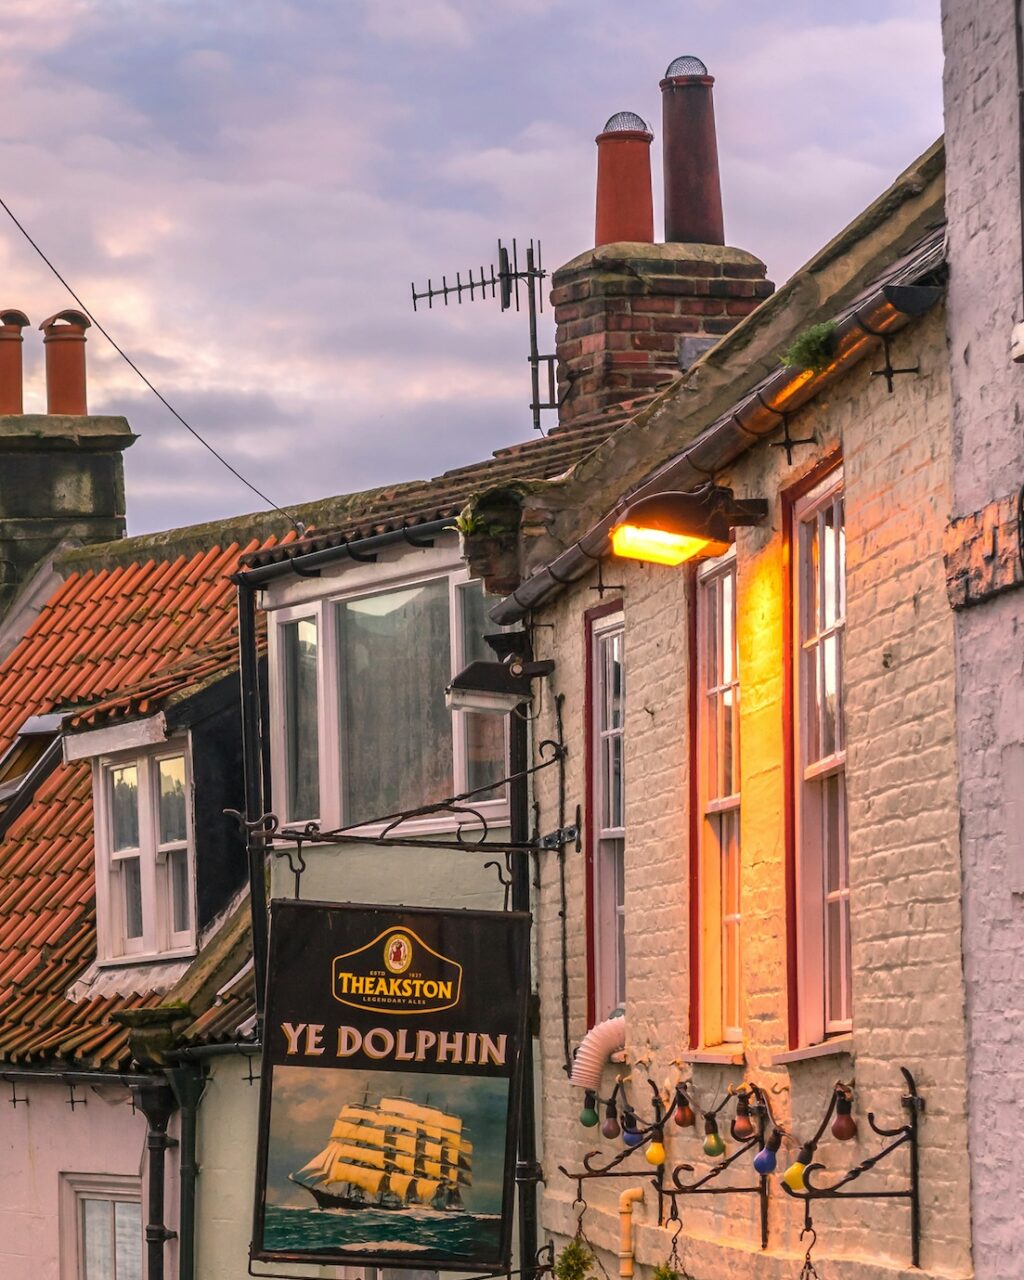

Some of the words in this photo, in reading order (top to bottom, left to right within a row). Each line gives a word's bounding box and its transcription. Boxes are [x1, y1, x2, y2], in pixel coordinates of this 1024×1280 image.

[338, 972, 453, 999] THEAKSTON
[362, 996, 406, 1004] LEGENDARY
[281, 1022, 325, 1056] YE
[336, 1025, 507, 1066] DOLPHIN
